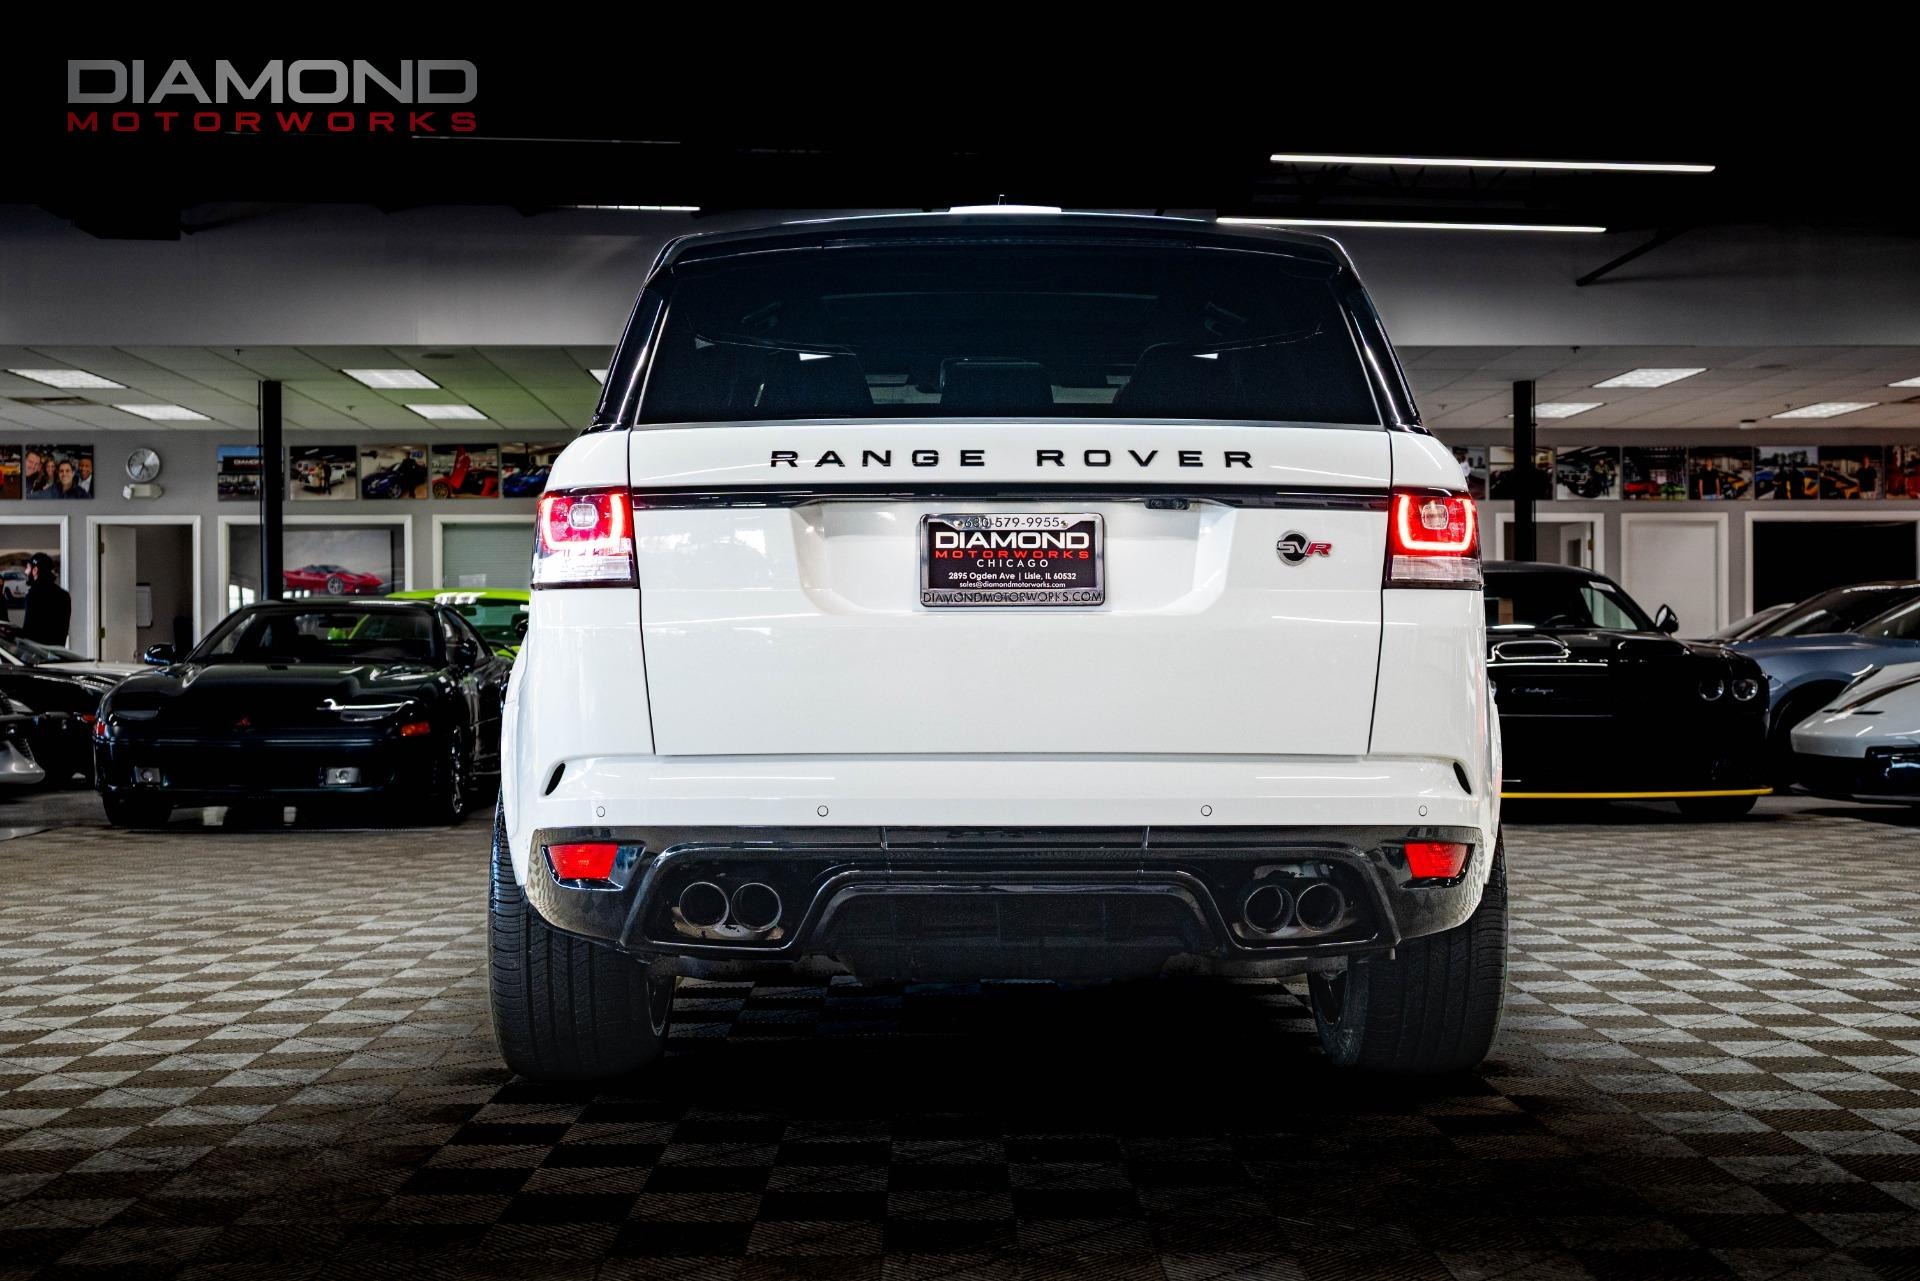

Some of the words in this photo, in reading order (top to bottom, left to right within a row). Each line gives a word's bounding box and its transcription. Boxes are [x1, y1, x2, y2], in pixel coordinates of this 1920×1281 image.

[770, 449, 986, 468] RANGE
[1036, 449, 1254, 468] ROVER
[935, 531, 1090, 549] DIAMOND
[935, 550, 1089, 559] MOTORWORKS
[1277, 539, 1333, 559] SVR
[976, 559, 1049, 568] CHICAGO
[948, 572, 968, 580] 2895
[969, 571, 998, 581] Ogden
[999, 572, 1016, 580] Ave
[1024, 572, 1043, 581] Lisle,
[1045, 572, 1052, 580] IL
[1053, 572, 1077, 580] 60532
[959, 580, 1066, 588] sales@diamondmotorworks.com
[923, 591, 1103, 603] DIAMONDMOTORWORKS.COM
